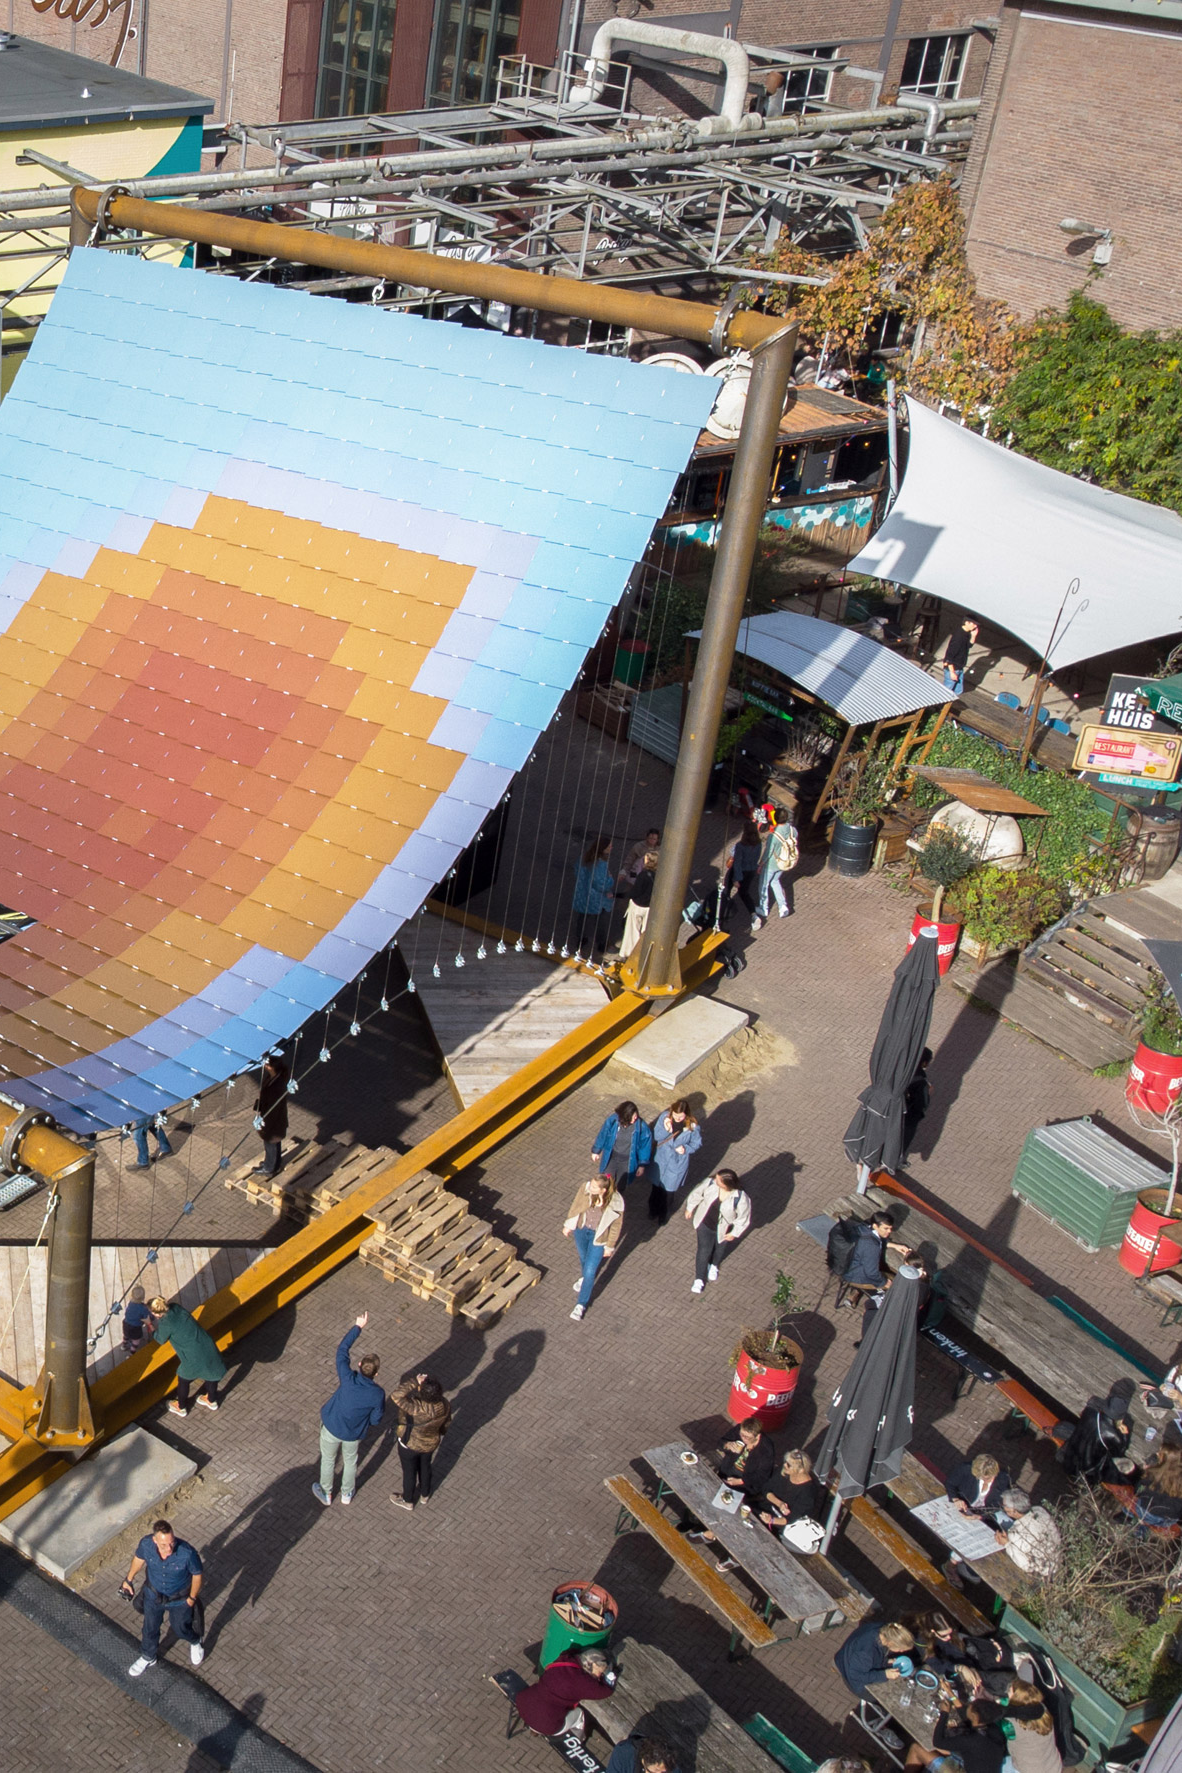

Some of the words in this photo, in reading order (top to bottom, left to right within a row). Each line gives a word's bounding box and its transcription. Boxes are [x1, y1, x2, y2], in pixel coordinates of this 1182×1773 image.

[1106, 708, 1155, 729] HUIS
[1094, 742, 1134, 756] RESTAURANT
[1102, 774, 1133, 785] LUNCH
